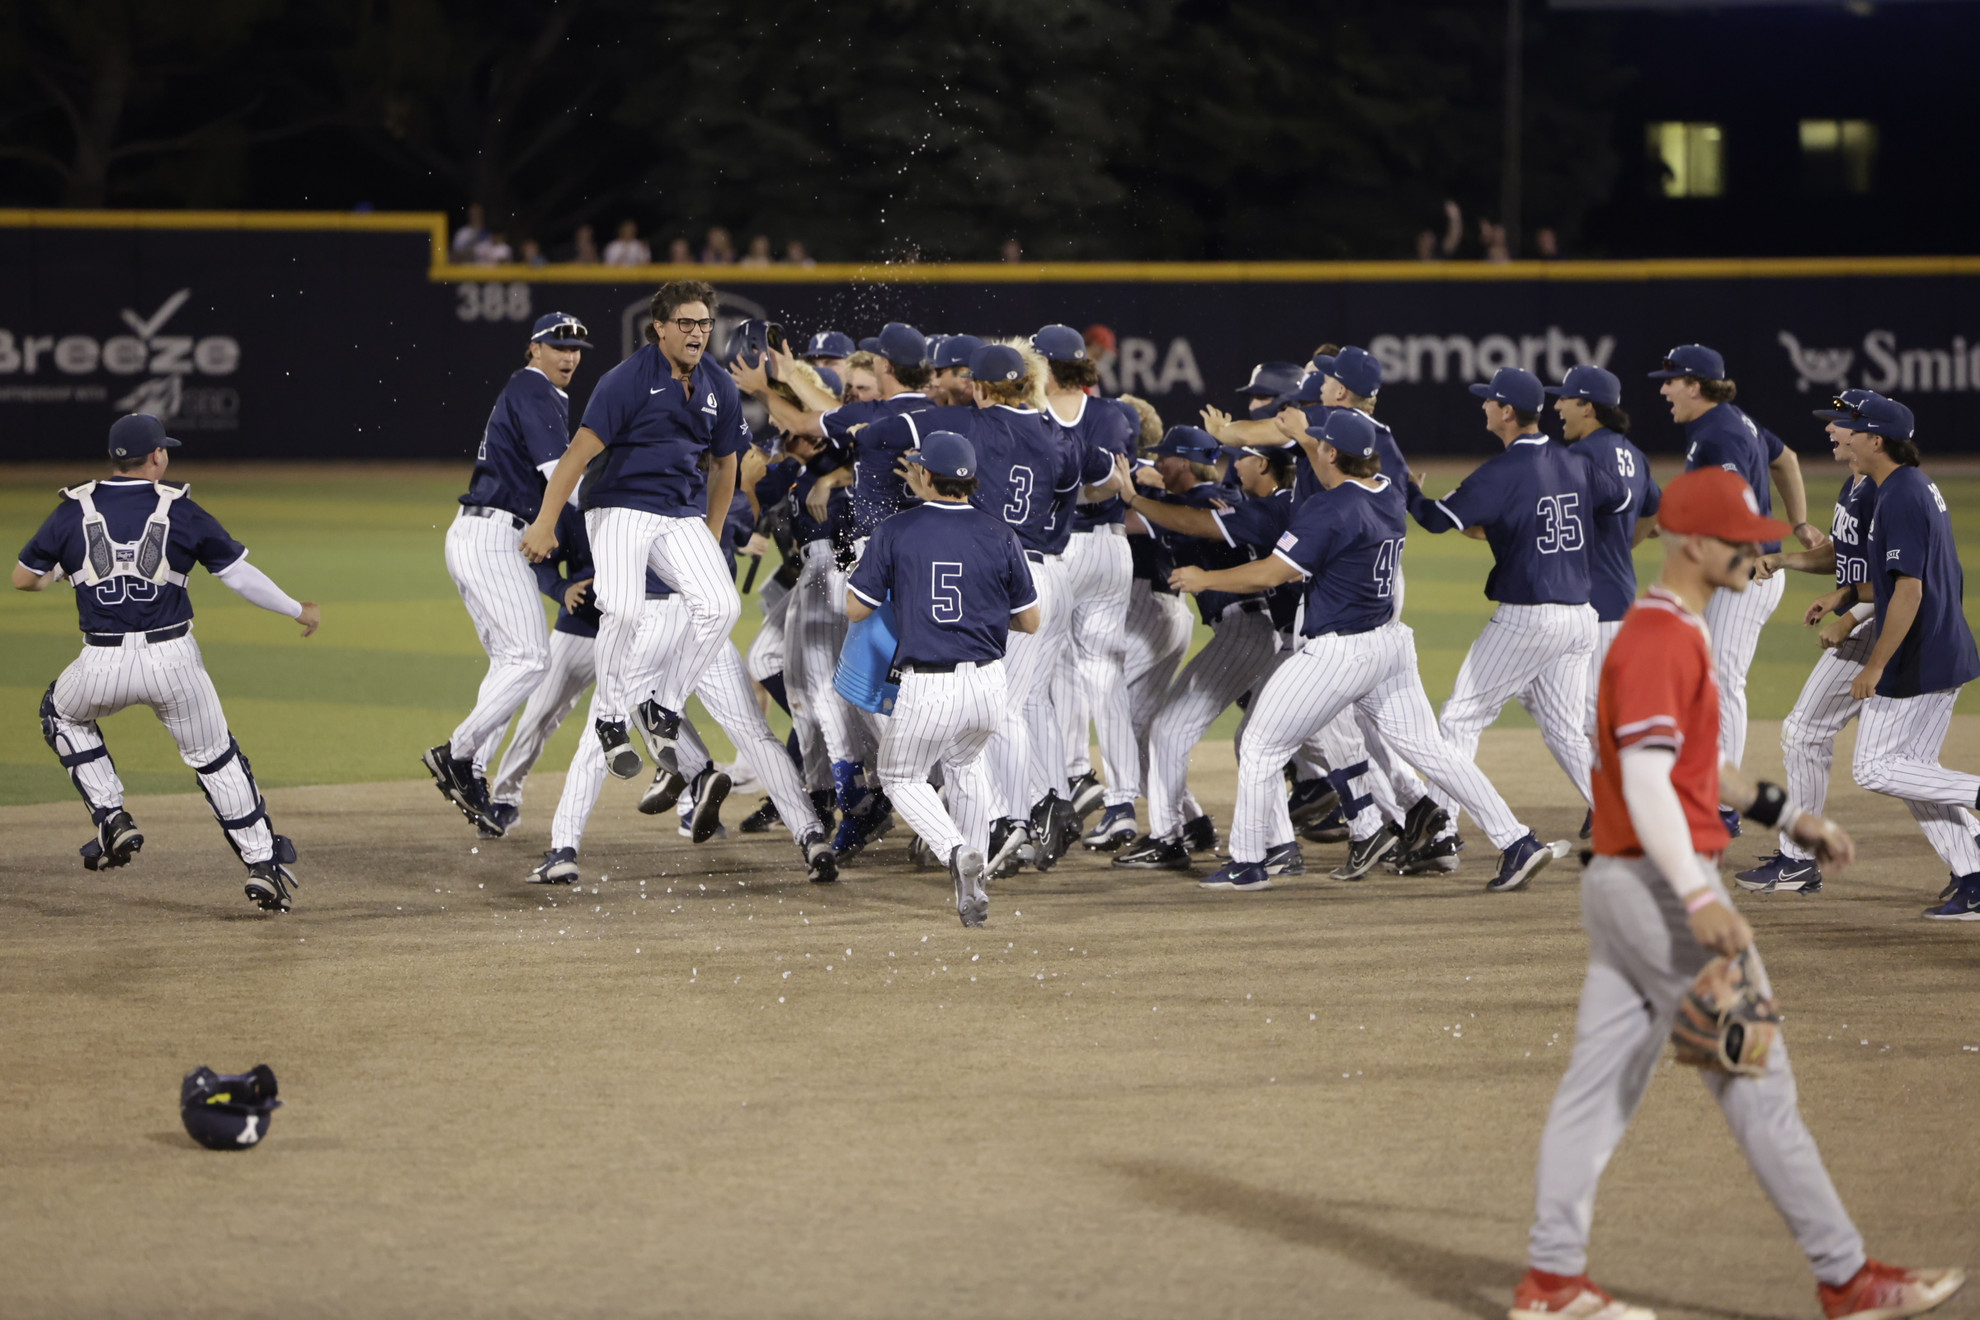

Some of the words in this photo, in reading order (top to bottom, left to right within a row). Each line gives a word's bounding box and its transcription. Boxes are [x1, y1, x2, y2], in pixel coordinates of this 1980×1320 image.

[457, 283, 532, 321] 388
[816, 333, 829, 349] Y
[1615, 447, 1635, 477] 53
[1003, 464, 1034, 524] 3
[1537, 492, 1584, 554] 35
[1836, 552, 1867, 584] 50
[932, 562, 963, 622] 5
